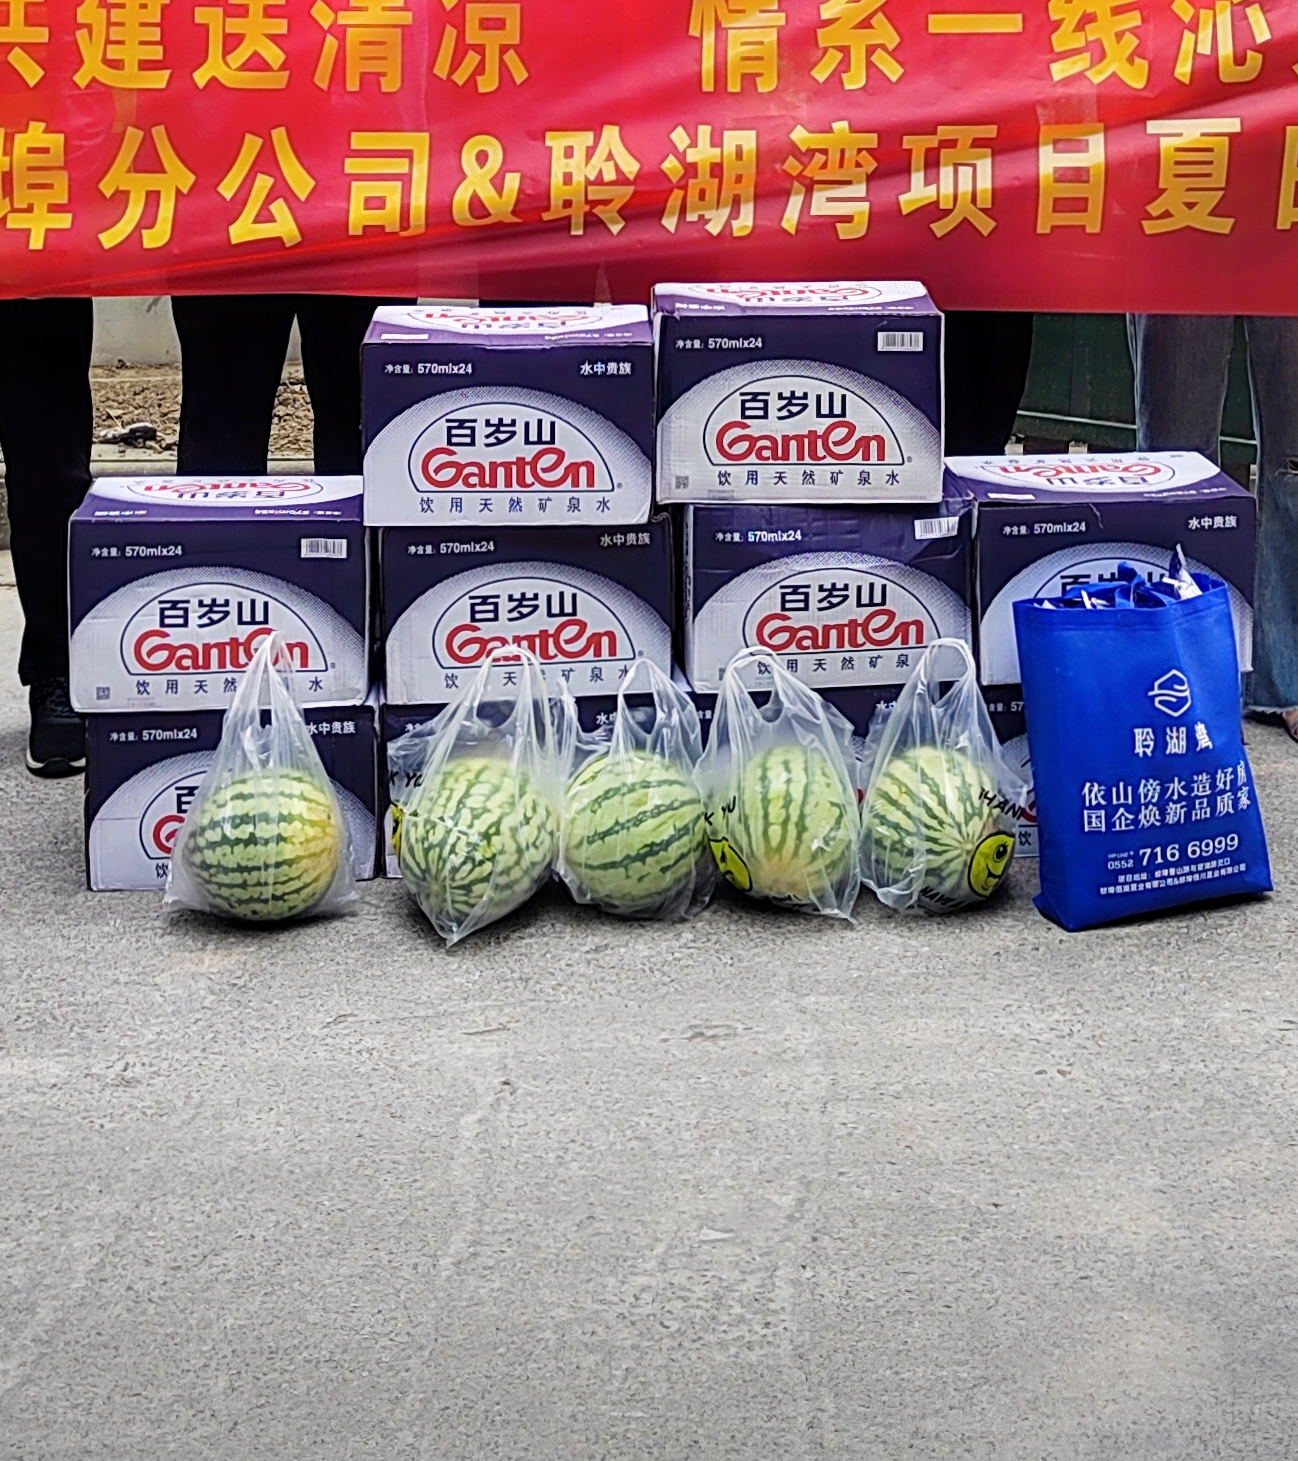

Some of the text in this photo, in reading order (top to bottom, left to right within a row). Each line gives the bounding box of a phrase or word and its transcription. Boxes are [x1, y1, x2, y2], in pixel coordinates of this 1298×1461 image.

[579, 360, 632, 376] 水中贵族
[739, 390, 848, 420] 百岁山
[445, 417, 556, 448] 百岁山
[716, 420, 886, 462] Ganten
[421, 447, 595, 489] Ganten
[717, 470, 900, 486] 饮用天然矿泉水
[419, 496, 611, 514] 饮用天然矿泉水
[1187, 516, 1238, 530] 水中贵族
[599, 532, 651, 547] 水中贵族
[469, 591, 578, 623] 百岁山
[779, 582, 887, 612] 百岁山
[158, 598, 269, 628] 百岁山
[756, 608, 924, 651] Ganten
[757, 653, 910, 675] 饮用天然矿泉
[135, 676, 323, 696] 饮用天然水
[305, 720, 356, 736] 水中贵族
[1081, 760, 1248, 807] 依山傍水造好房
[1083, 786, 1251, 833] 国企焕新品质家
[1107, 833, 1239, 870] 0552 716 6999
